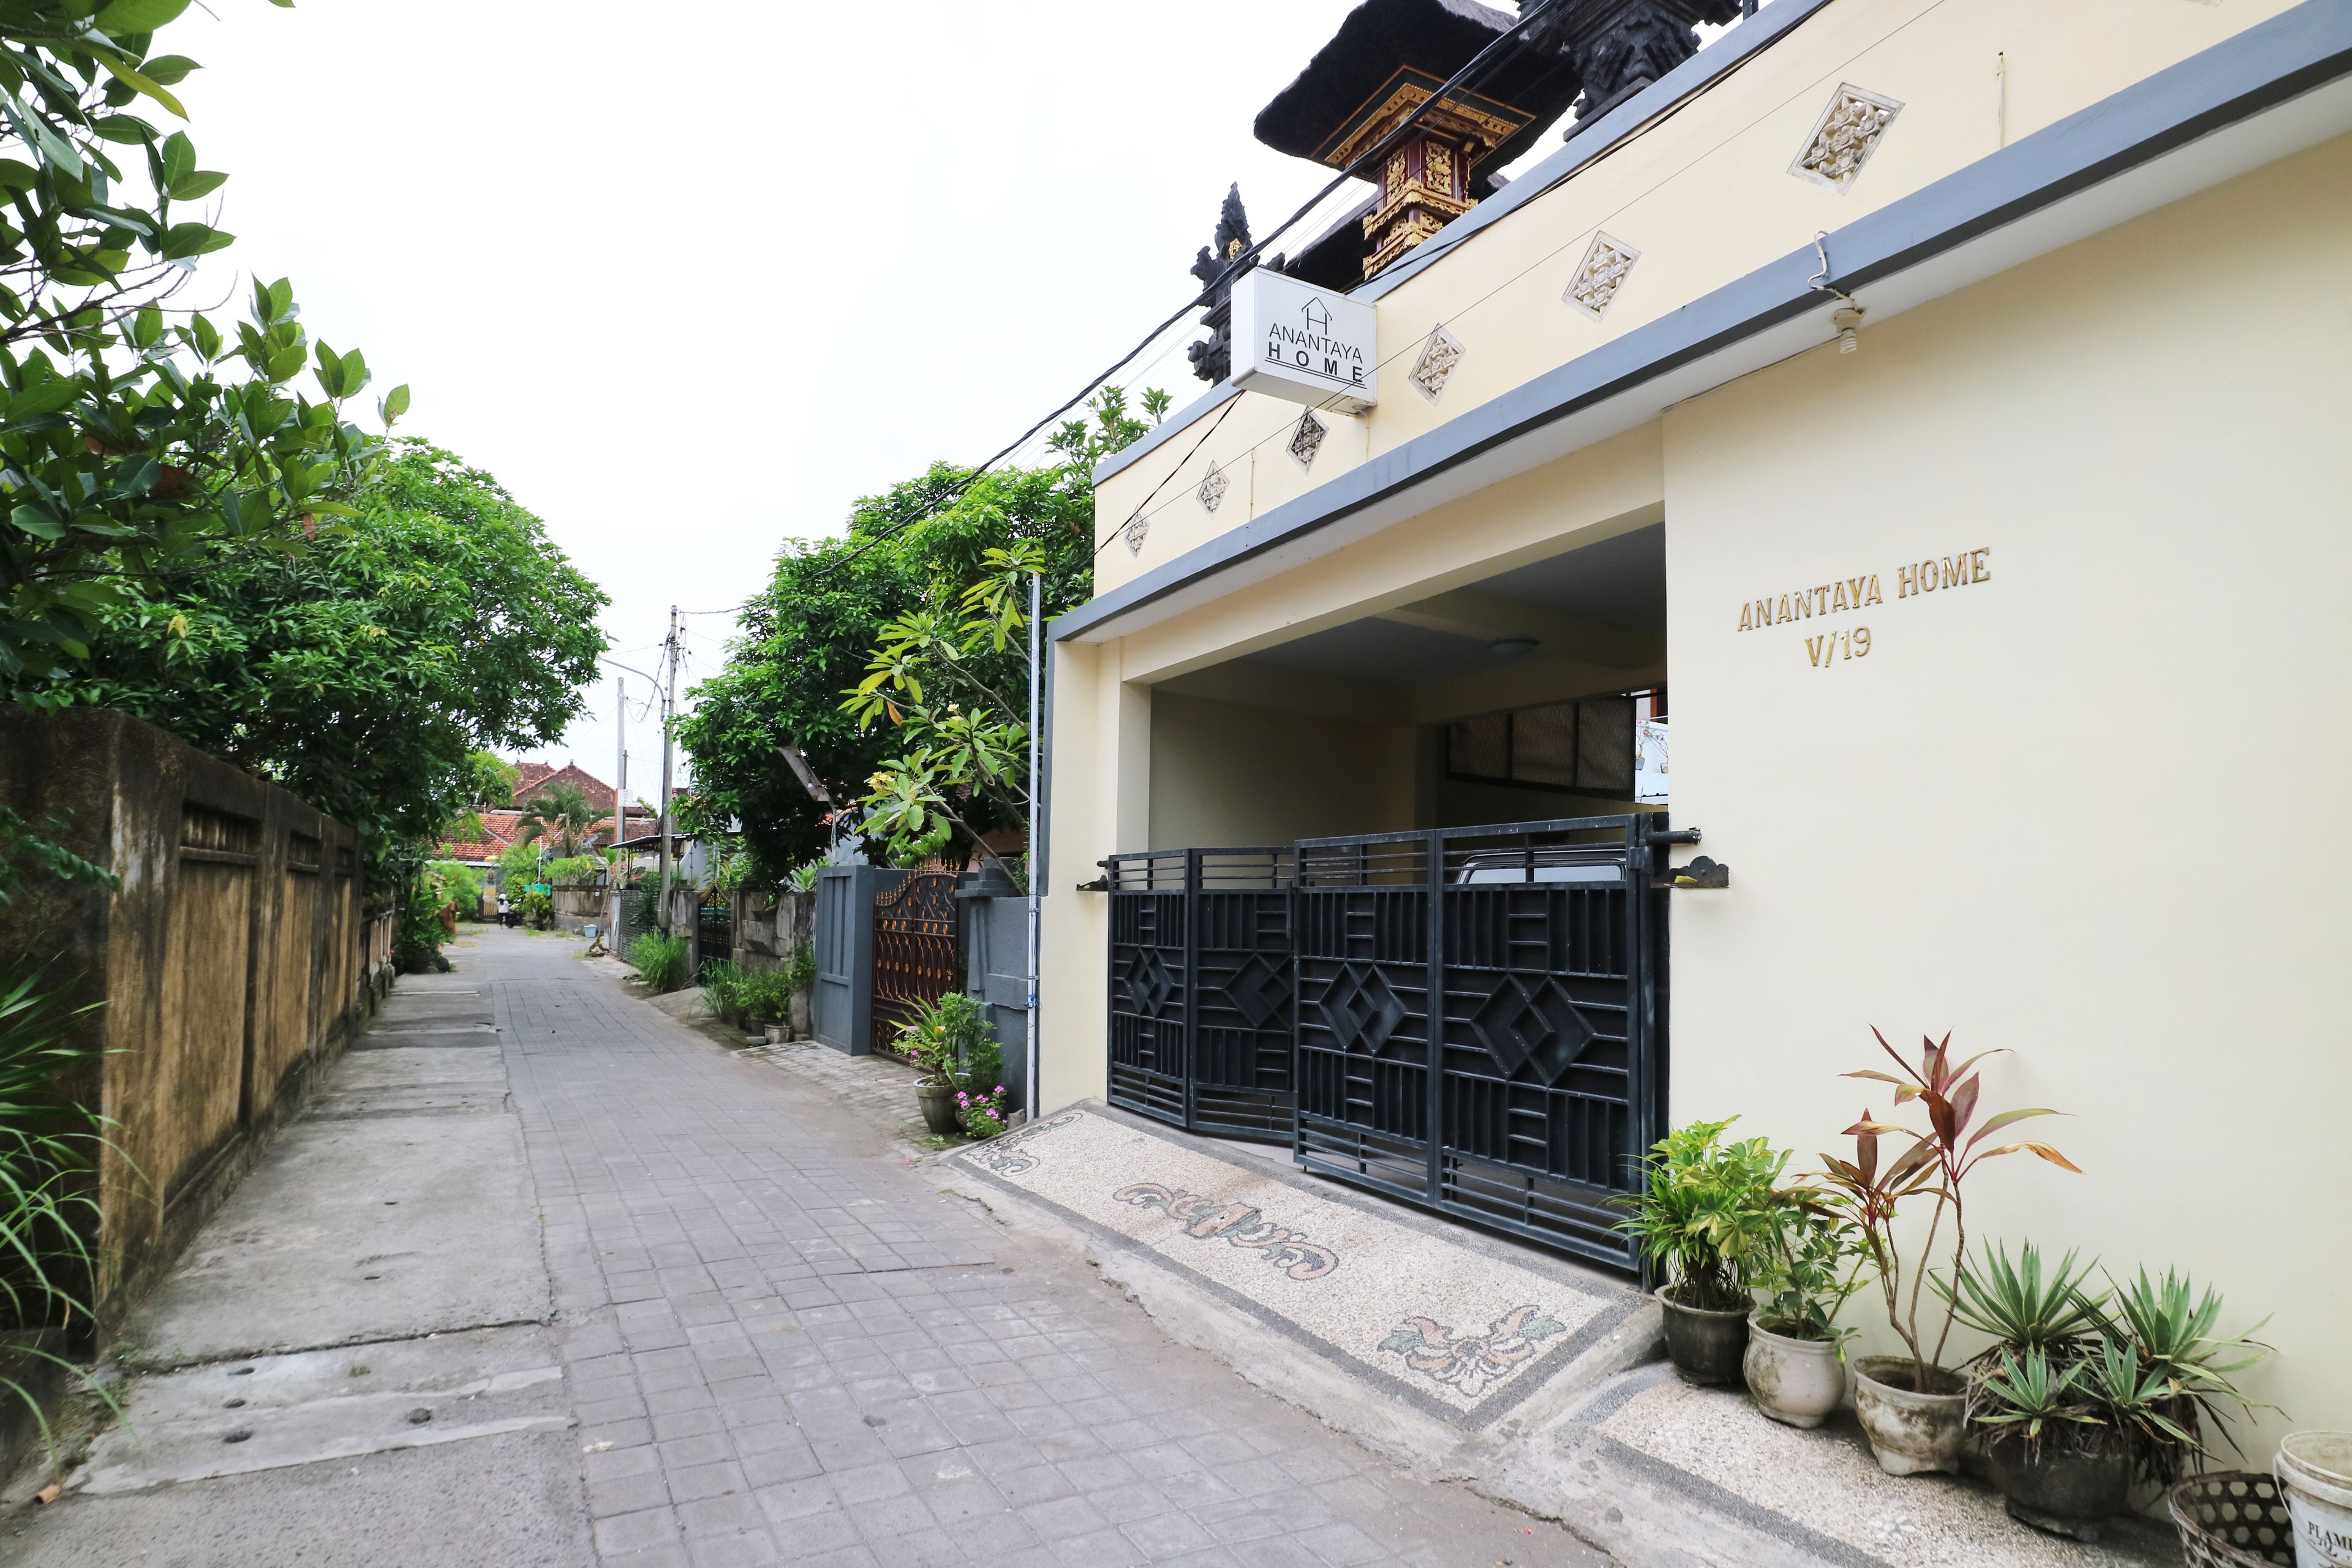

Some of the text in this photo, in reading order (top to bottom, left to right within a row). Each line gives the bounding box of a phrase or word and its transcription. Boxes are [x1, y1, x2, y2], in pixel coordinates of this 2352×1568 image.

[1268, 323, 1363, 364] ANANTAYA
[1268, 341, 1363, 383] HOME
[1737, 547, 1991, 631] ANANTAYA HOME
[1804, 626, 1872, 668] V/19
